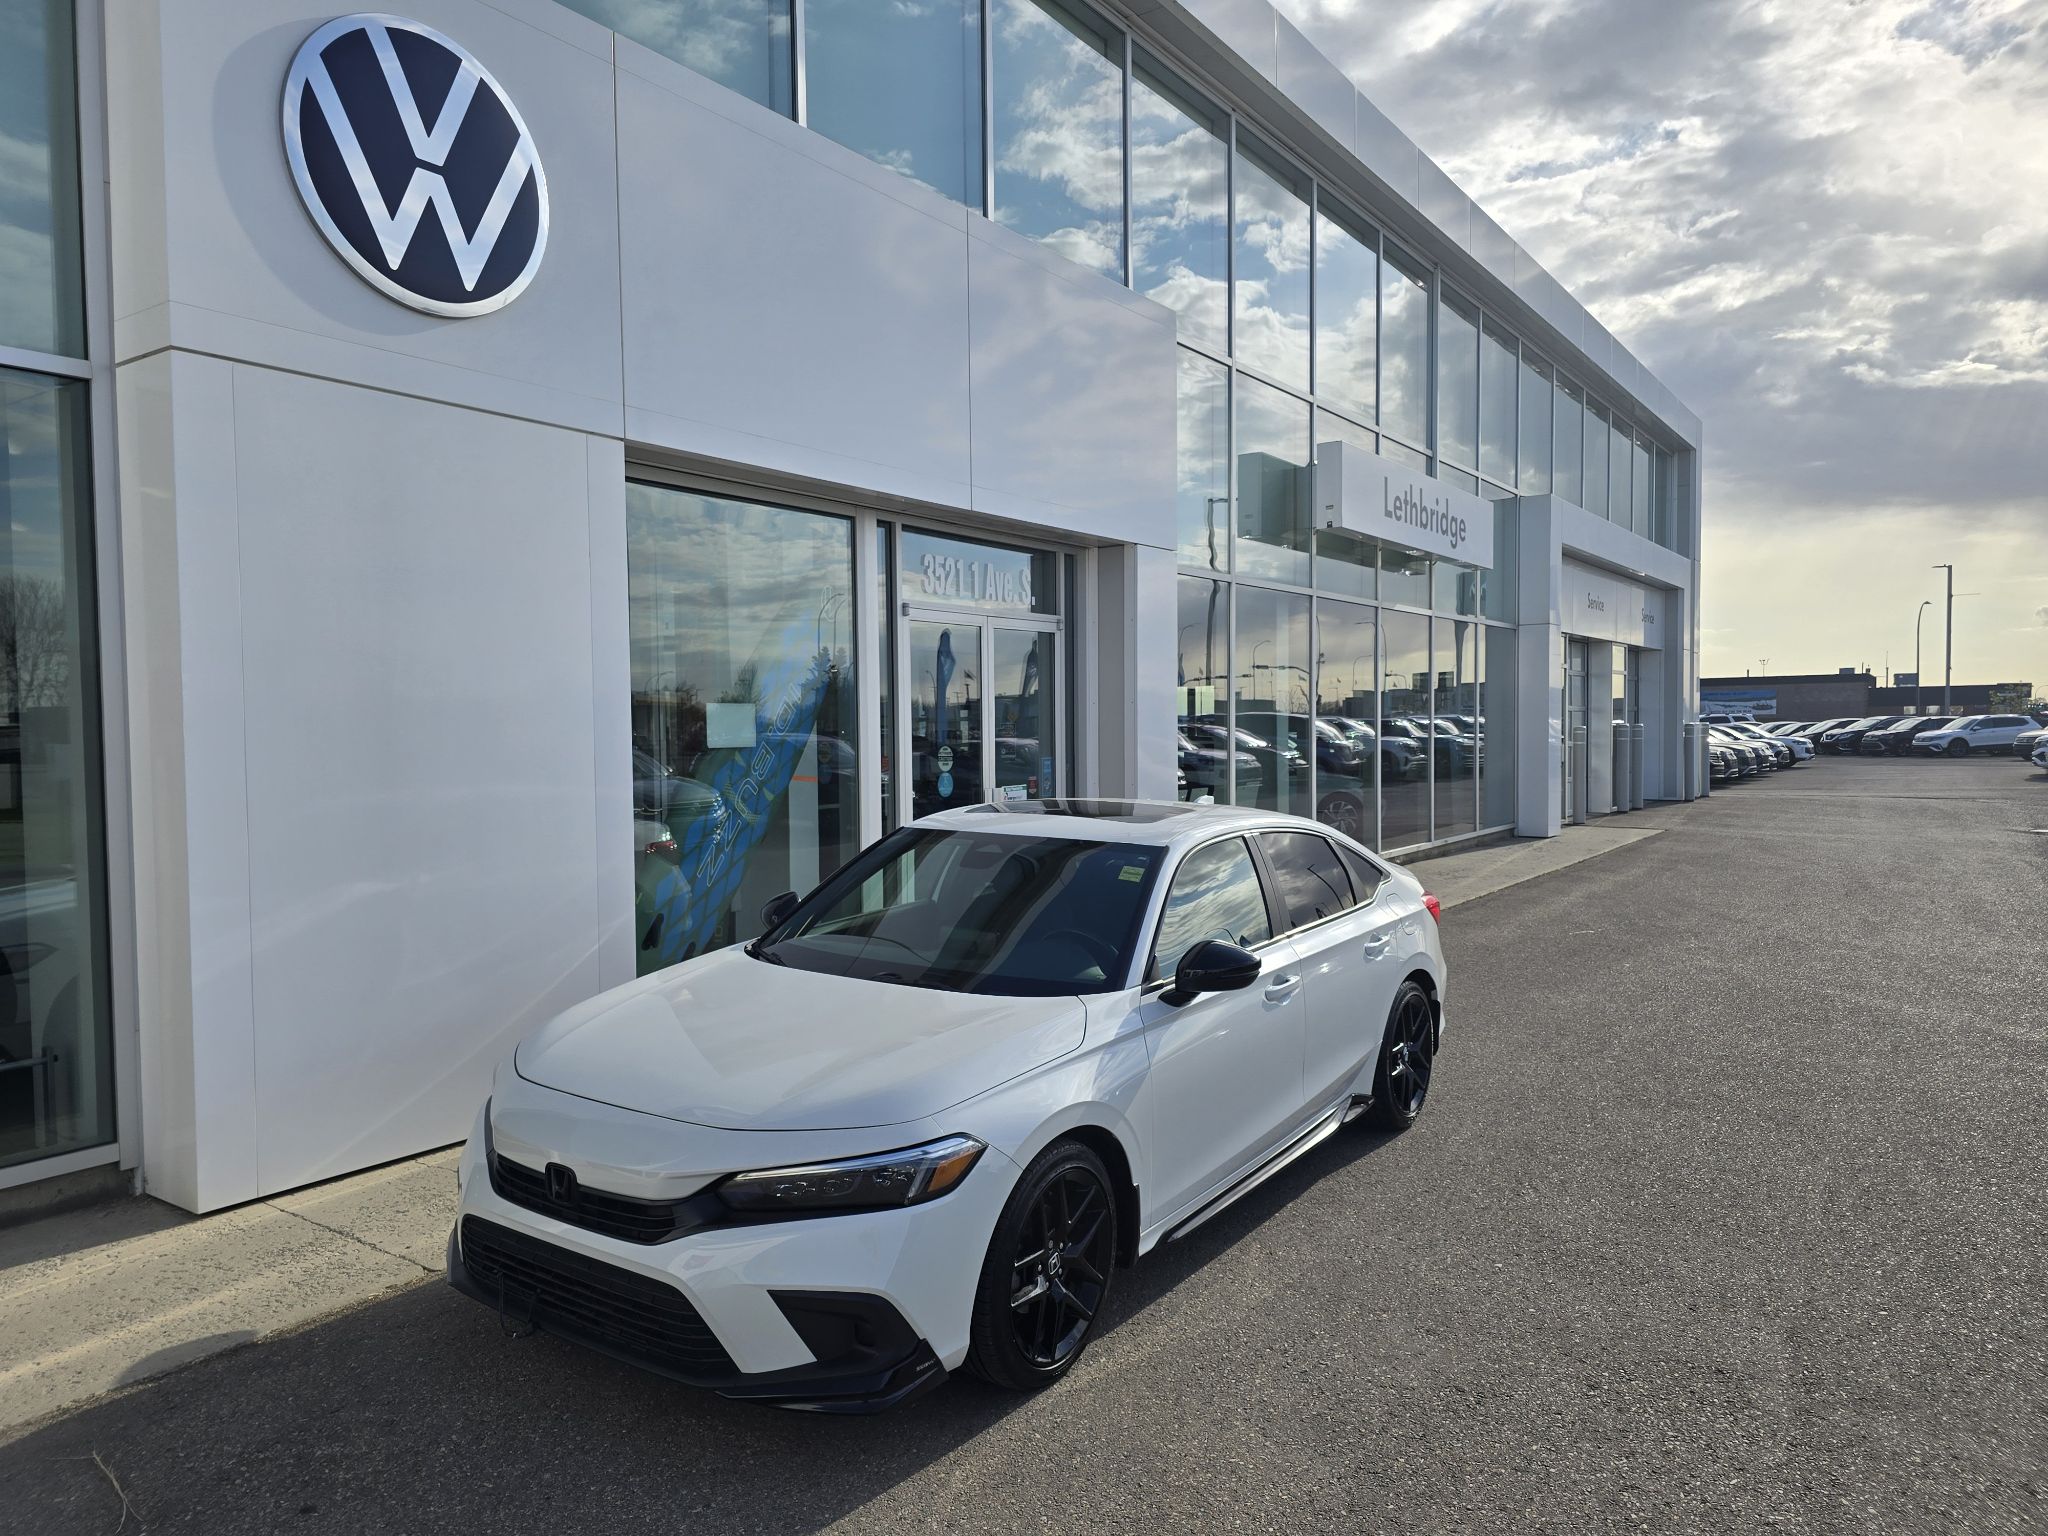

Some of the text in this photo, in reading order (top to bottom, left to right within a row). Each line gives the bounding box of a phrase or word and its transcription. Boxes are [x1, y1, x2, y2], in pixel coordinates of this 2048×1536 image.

[1384, 476, 1467, 549] Lethbridge
[922, 553, 1036, 606] 3521 1 Ave. S.
[1587, 592, 1605, 612] Service
[1641, 607, 1655, 624] Service
